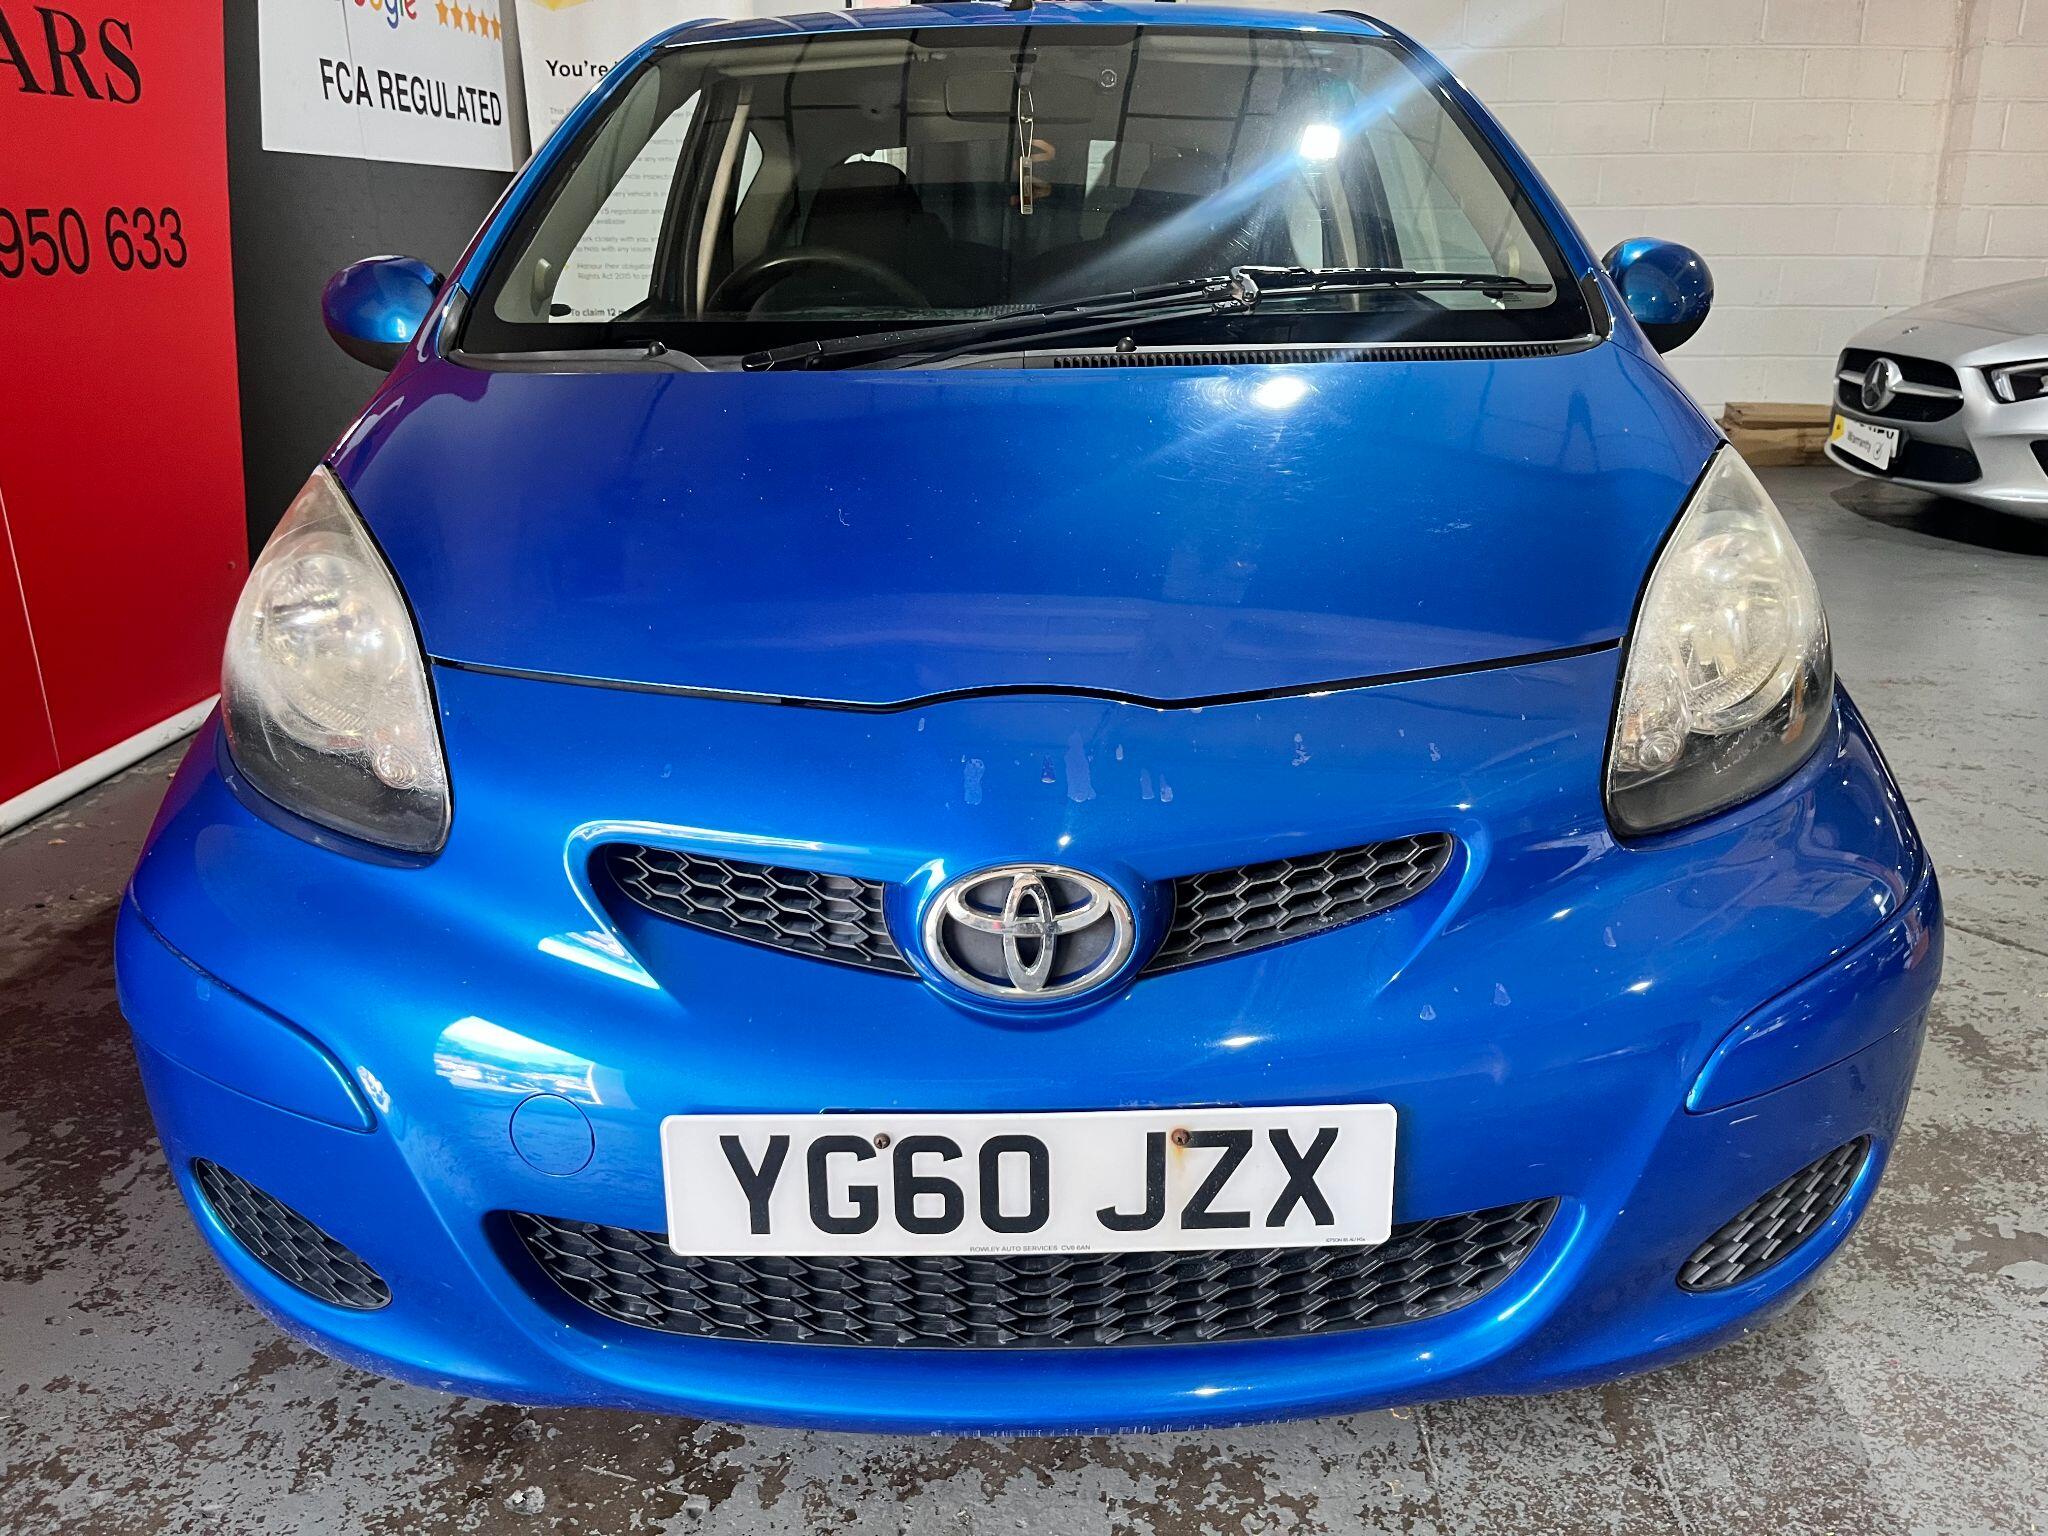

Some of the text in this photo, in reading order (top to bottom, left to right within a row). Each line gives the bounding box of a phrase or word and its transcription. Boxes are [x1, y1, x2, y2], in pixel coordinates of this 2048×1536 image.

[319, 58, 502, 126] FCA REGULATED
[0, 206, 188, 279] 950 633
[582, 307, 606, 317] claim
[607, 307, 617, 317] 12
[719, 1127, 1339, 1236] YG60 JZX
[969, 1245, 1000, 1253] ROWLEY
[1022, 1244, 1058, 1252] SERVICES
